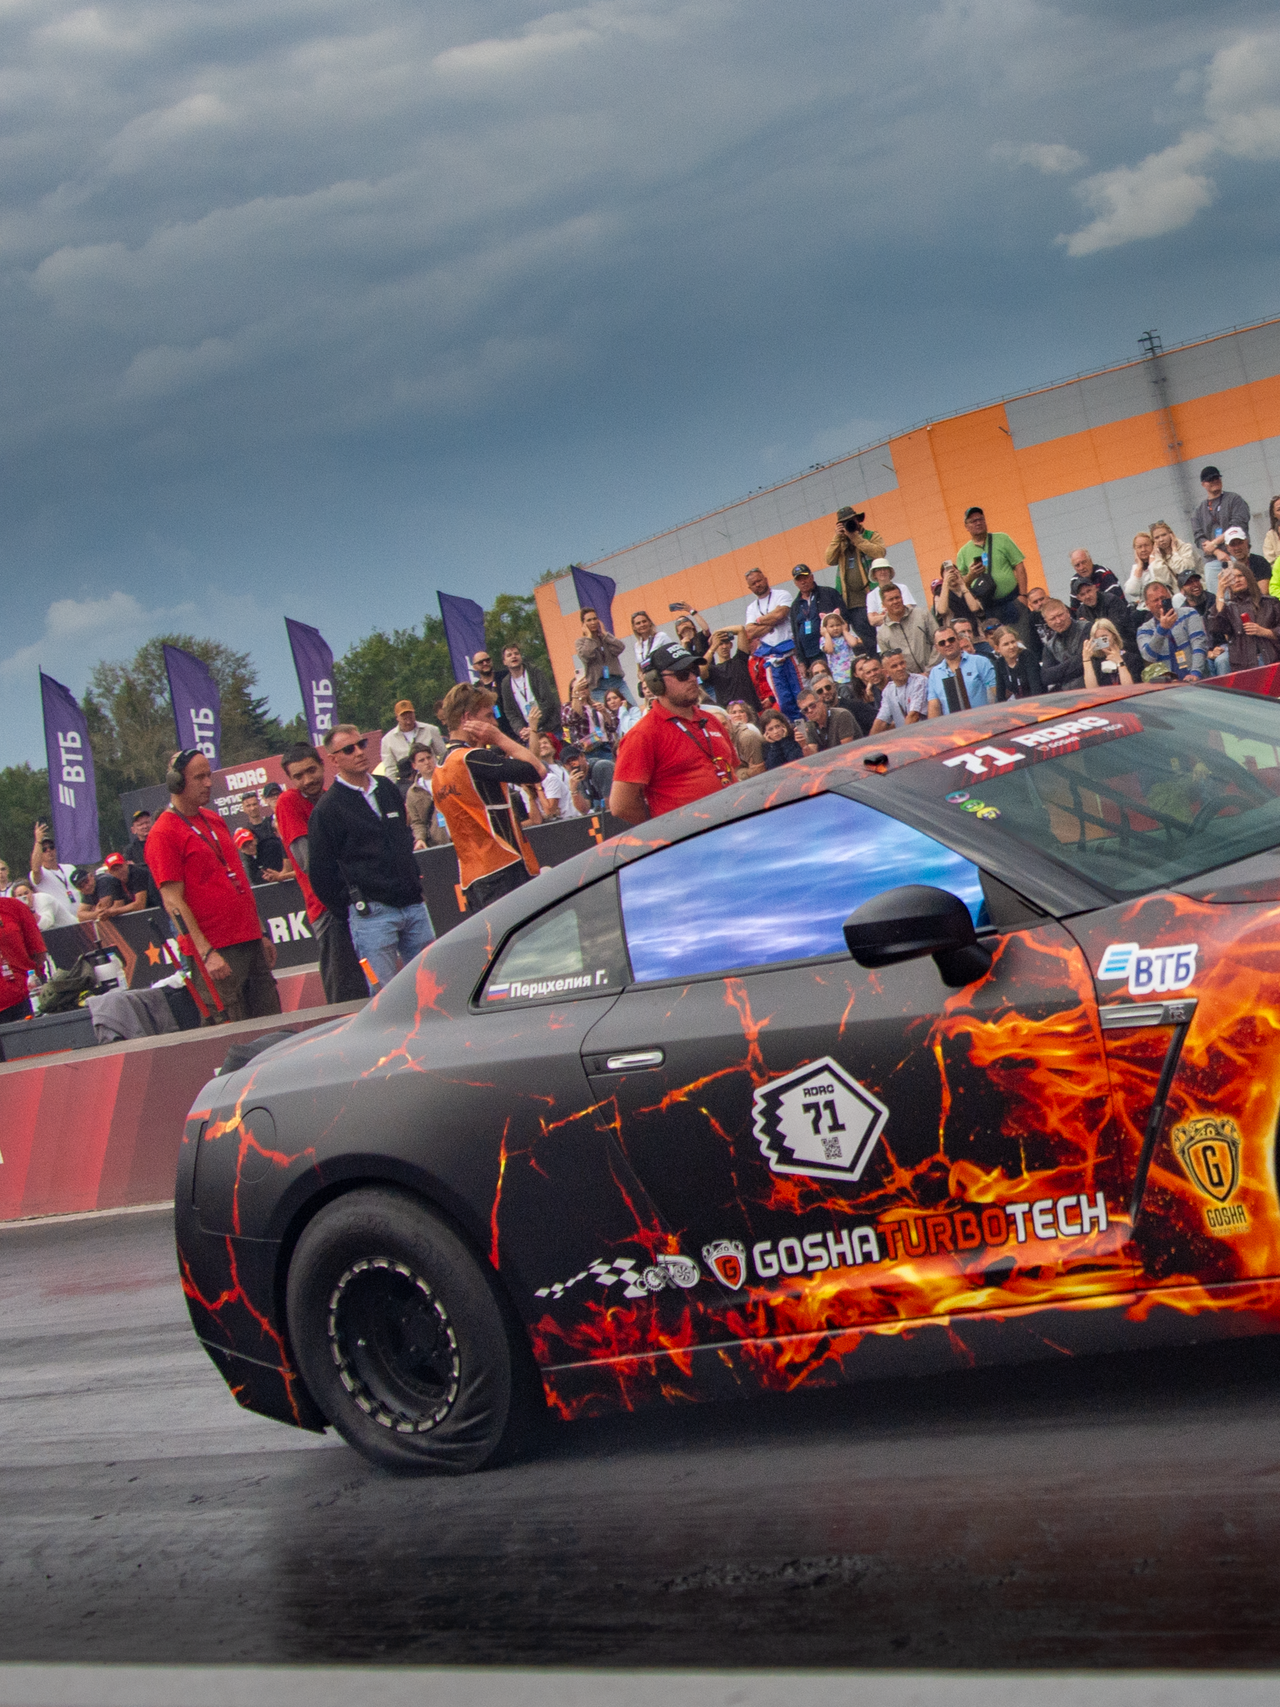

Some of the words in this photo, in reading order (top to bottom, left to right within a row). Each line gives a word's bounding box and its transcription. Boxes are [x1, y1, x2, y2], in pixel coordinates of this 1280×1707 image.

[311, 678, 334, 730] ВТБ
[190, 706, 215, 759] ВТБ
[57, 730, 86, 783] ВТБ
[942, 745, 1026, 774] 71
[225, 767, 268, 792] RDRC
[510, 975, 592, 998] Перцхелия
[595, 969, 608, 985] Г.
[1134, 951, 1192, 988] ВТБ
[802, 1084, 835, 1098] RDRC
[802, 1099, 846, 1136] 71
[1202, 1145, 1225, 1187] G
[1206, 1205, 1247, 1227] GOSHA
